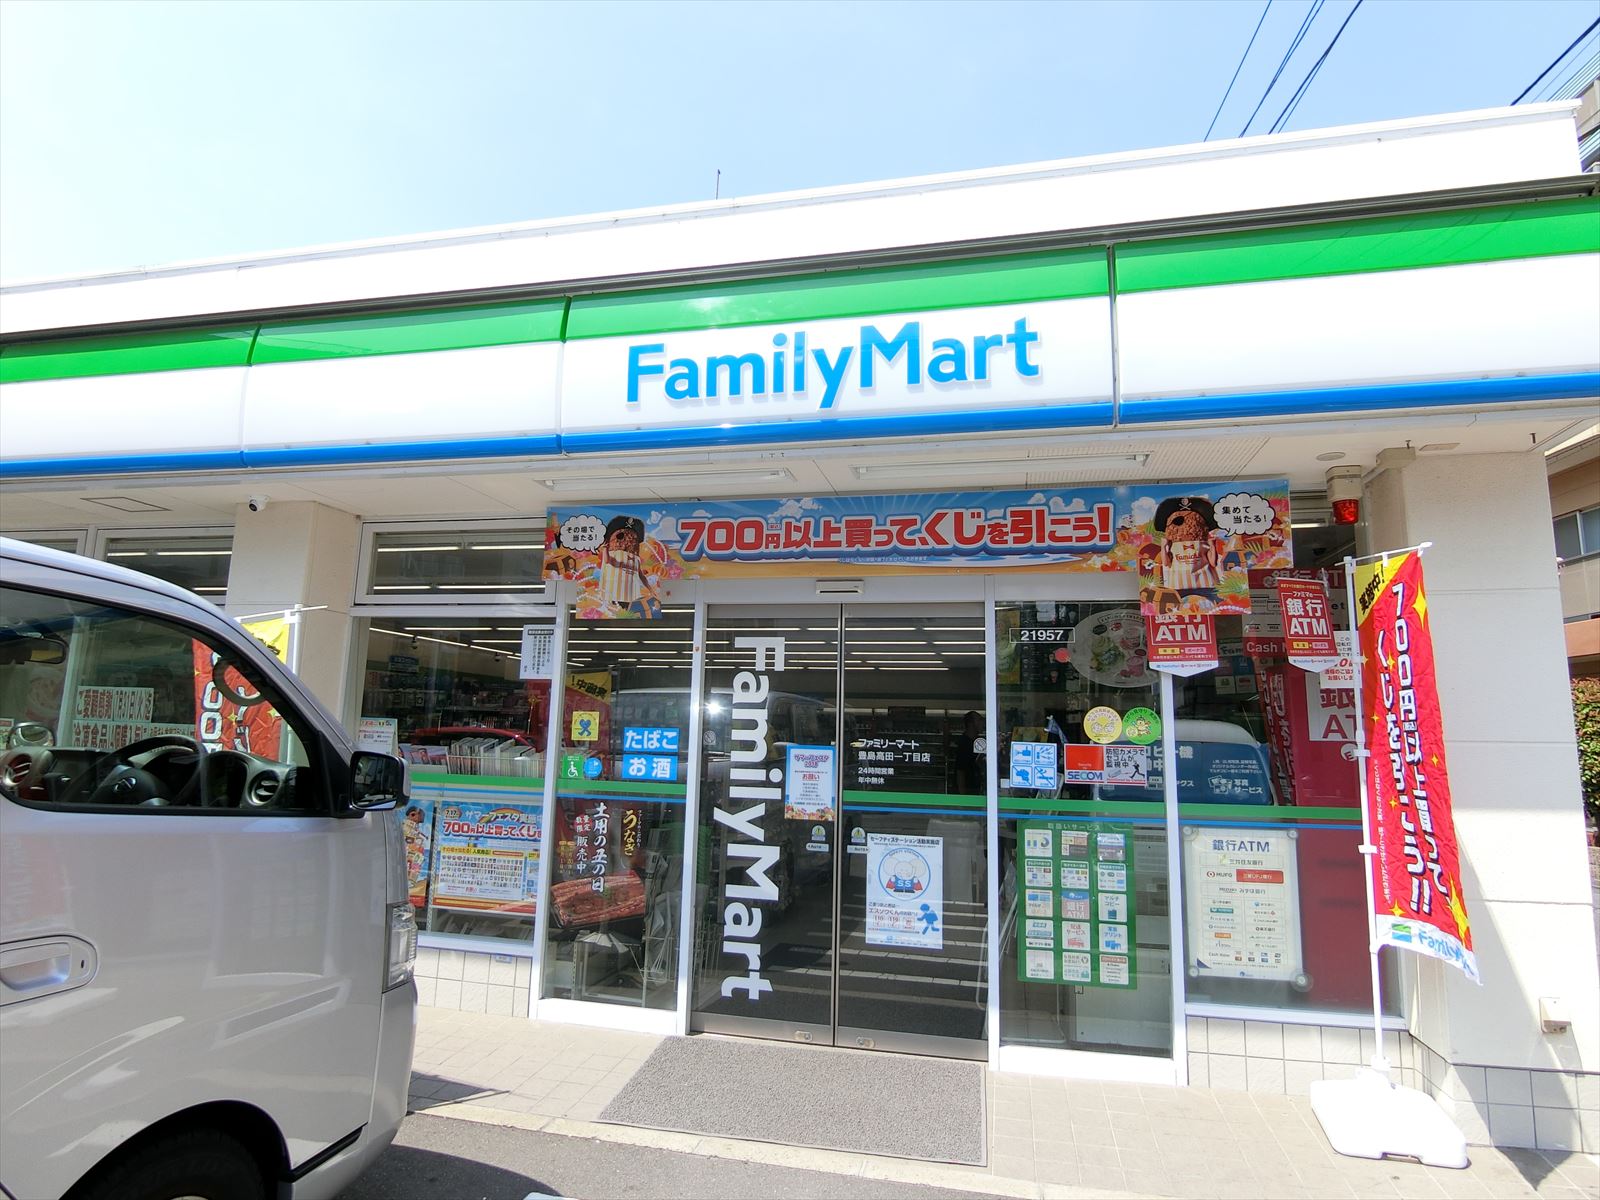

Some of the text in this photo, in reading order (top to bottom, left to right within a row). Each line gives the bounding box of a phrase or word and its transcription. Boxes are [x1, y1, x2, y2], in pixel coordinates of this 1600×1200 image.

[627, 316, 1040, 409] FamilyMart
[1222, 506, 1250, 514] 集めて
[567, 526, 595, 534] その場で
[1285, 598, 1323, 617] 銀行
[1155, 624, 1207, 641] ATM
[1290, 618, 1328, 635] ATM
[1020, 630, 1064, 641] 21957
[1246, 642, 1278, 653] Cash
[625, 729, 678, 749] たばこ
[858, 739, 920, 750] ファミリーマート
[858, 751, 931, 762] 豊島高田一丁目店
[1105, 748, 1145, 756] 防犯カメラで
[627, 757, 672, 779] お酒
[858, 767, 895, 775] 24時間営業
[1067, 771, 1103, 781] SECOM
[713, 636, 785, 1000] FamilyMart
[622, 809, 638, 856] うなぎ
[591, 802, 611, 893] 土用の丑の日
[1212, 839, 1270, 852] 銀行ATM
[576, 836, 589, 875] 販売中
[897, 880, 911, 888] SS
